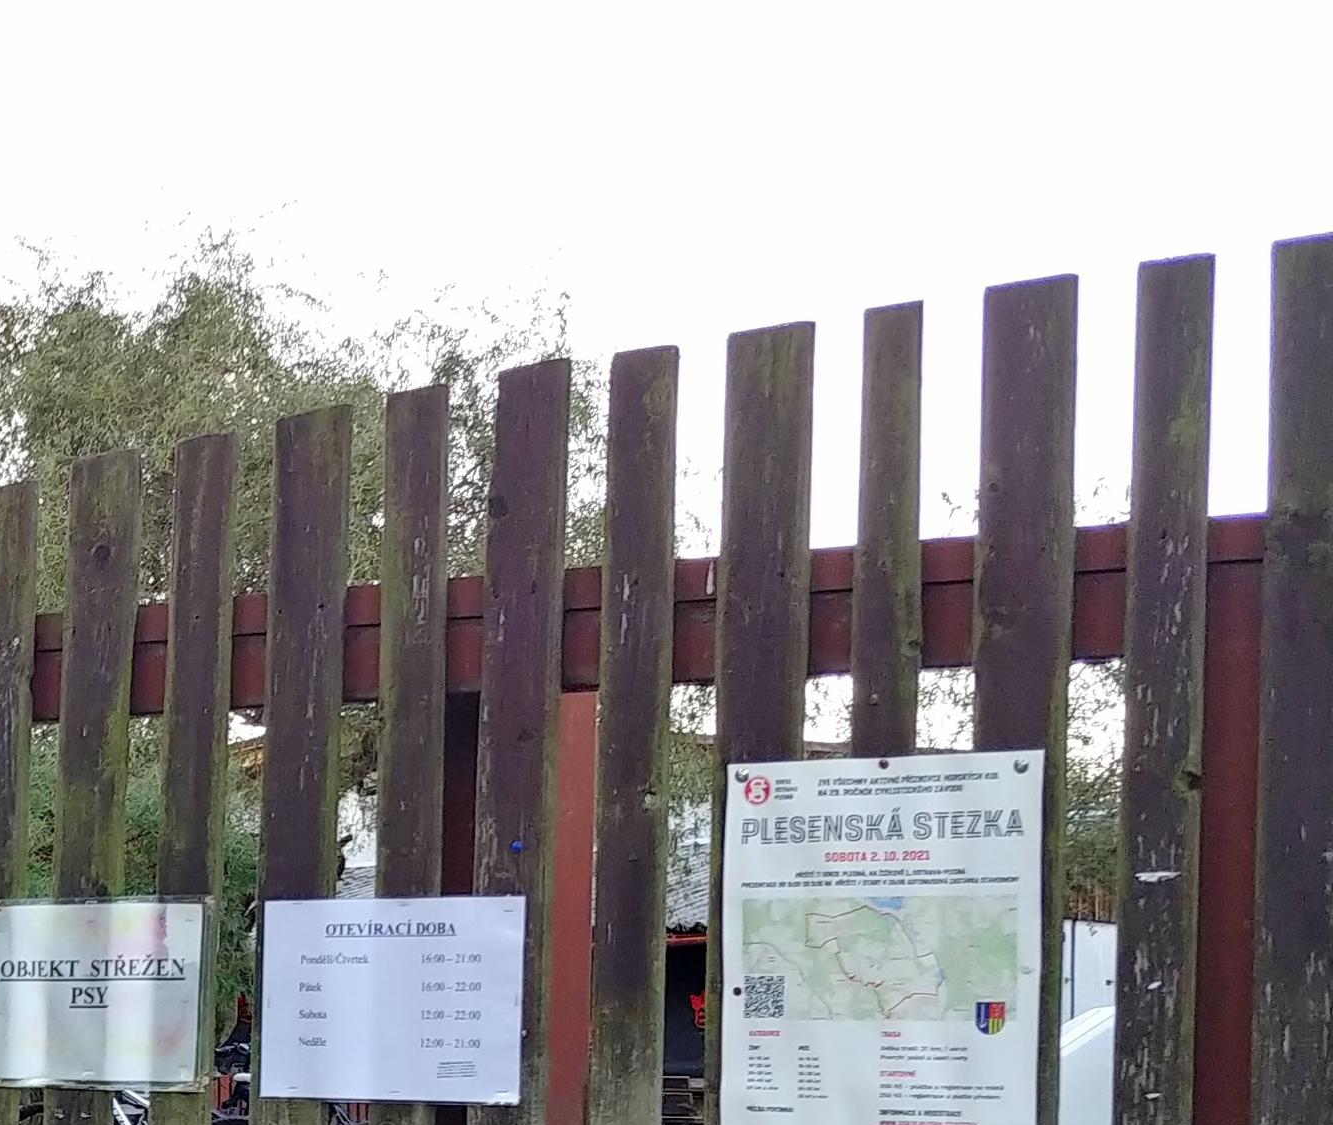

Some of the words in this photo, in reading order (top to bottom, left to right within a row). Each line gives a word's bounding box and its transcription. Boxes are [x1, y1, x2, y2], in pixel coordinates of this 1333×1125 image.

[741, 807, 904, 845] PLESENSKÁ
[913, 809, 1025, 841] STEZKA
[824, 851, 867, 863] SOBOTA
[871, 851, 881, 862] 2.
[883, 851, 900, 862] 10.
[902, 850, 931, 862] 2021
[325, 919, 412, 938] OTEVÍRACÍ
[416, 922, 456, 937] DOBA
[0, 959, 80, 978] OBJEKT
[90, 953, 186, 978] STŘEŽEN
[454, 981, 482, 992] 22:00
[71, 986, 108, 1004] PSY
[298, 1009, 328, 1020] Sobota
[454, 1010, 482, 1020] 22:00
